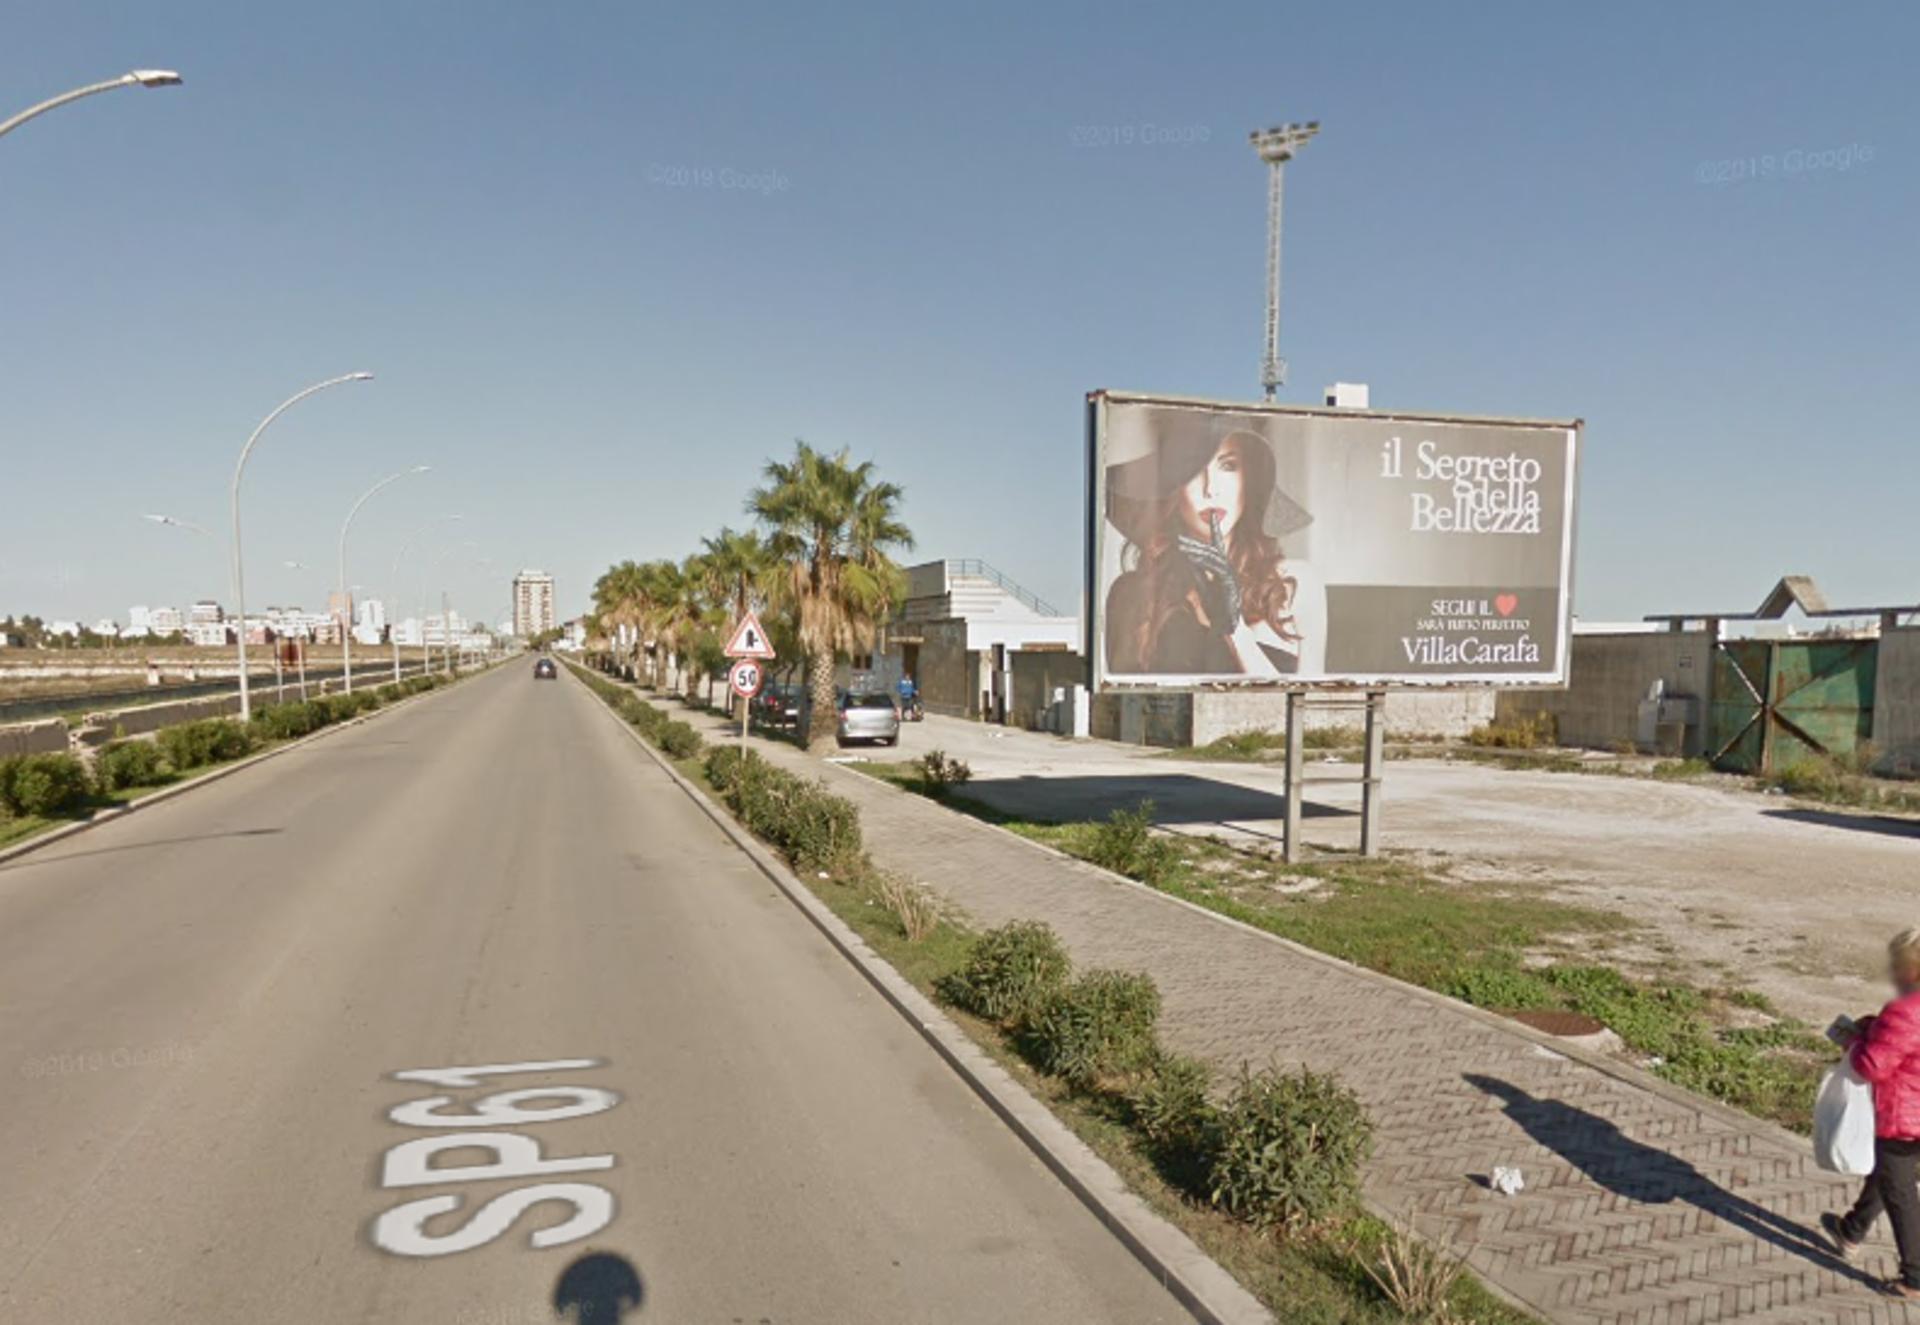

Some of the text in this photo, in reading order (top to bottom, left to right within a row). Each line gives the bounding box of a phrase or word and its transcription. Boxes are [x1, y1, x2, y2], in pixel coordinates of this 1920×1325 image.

[1381, 437, 1541, 499] il Segreto
[1410, 493, 1541, 534] Bellezza
[1472, 478, 1541, 514] della
[1401, 634, 1539, 664] VillaCarafa
[738, 670, 757, 687] 50
[373, 1057, 622, 1257] SP61
